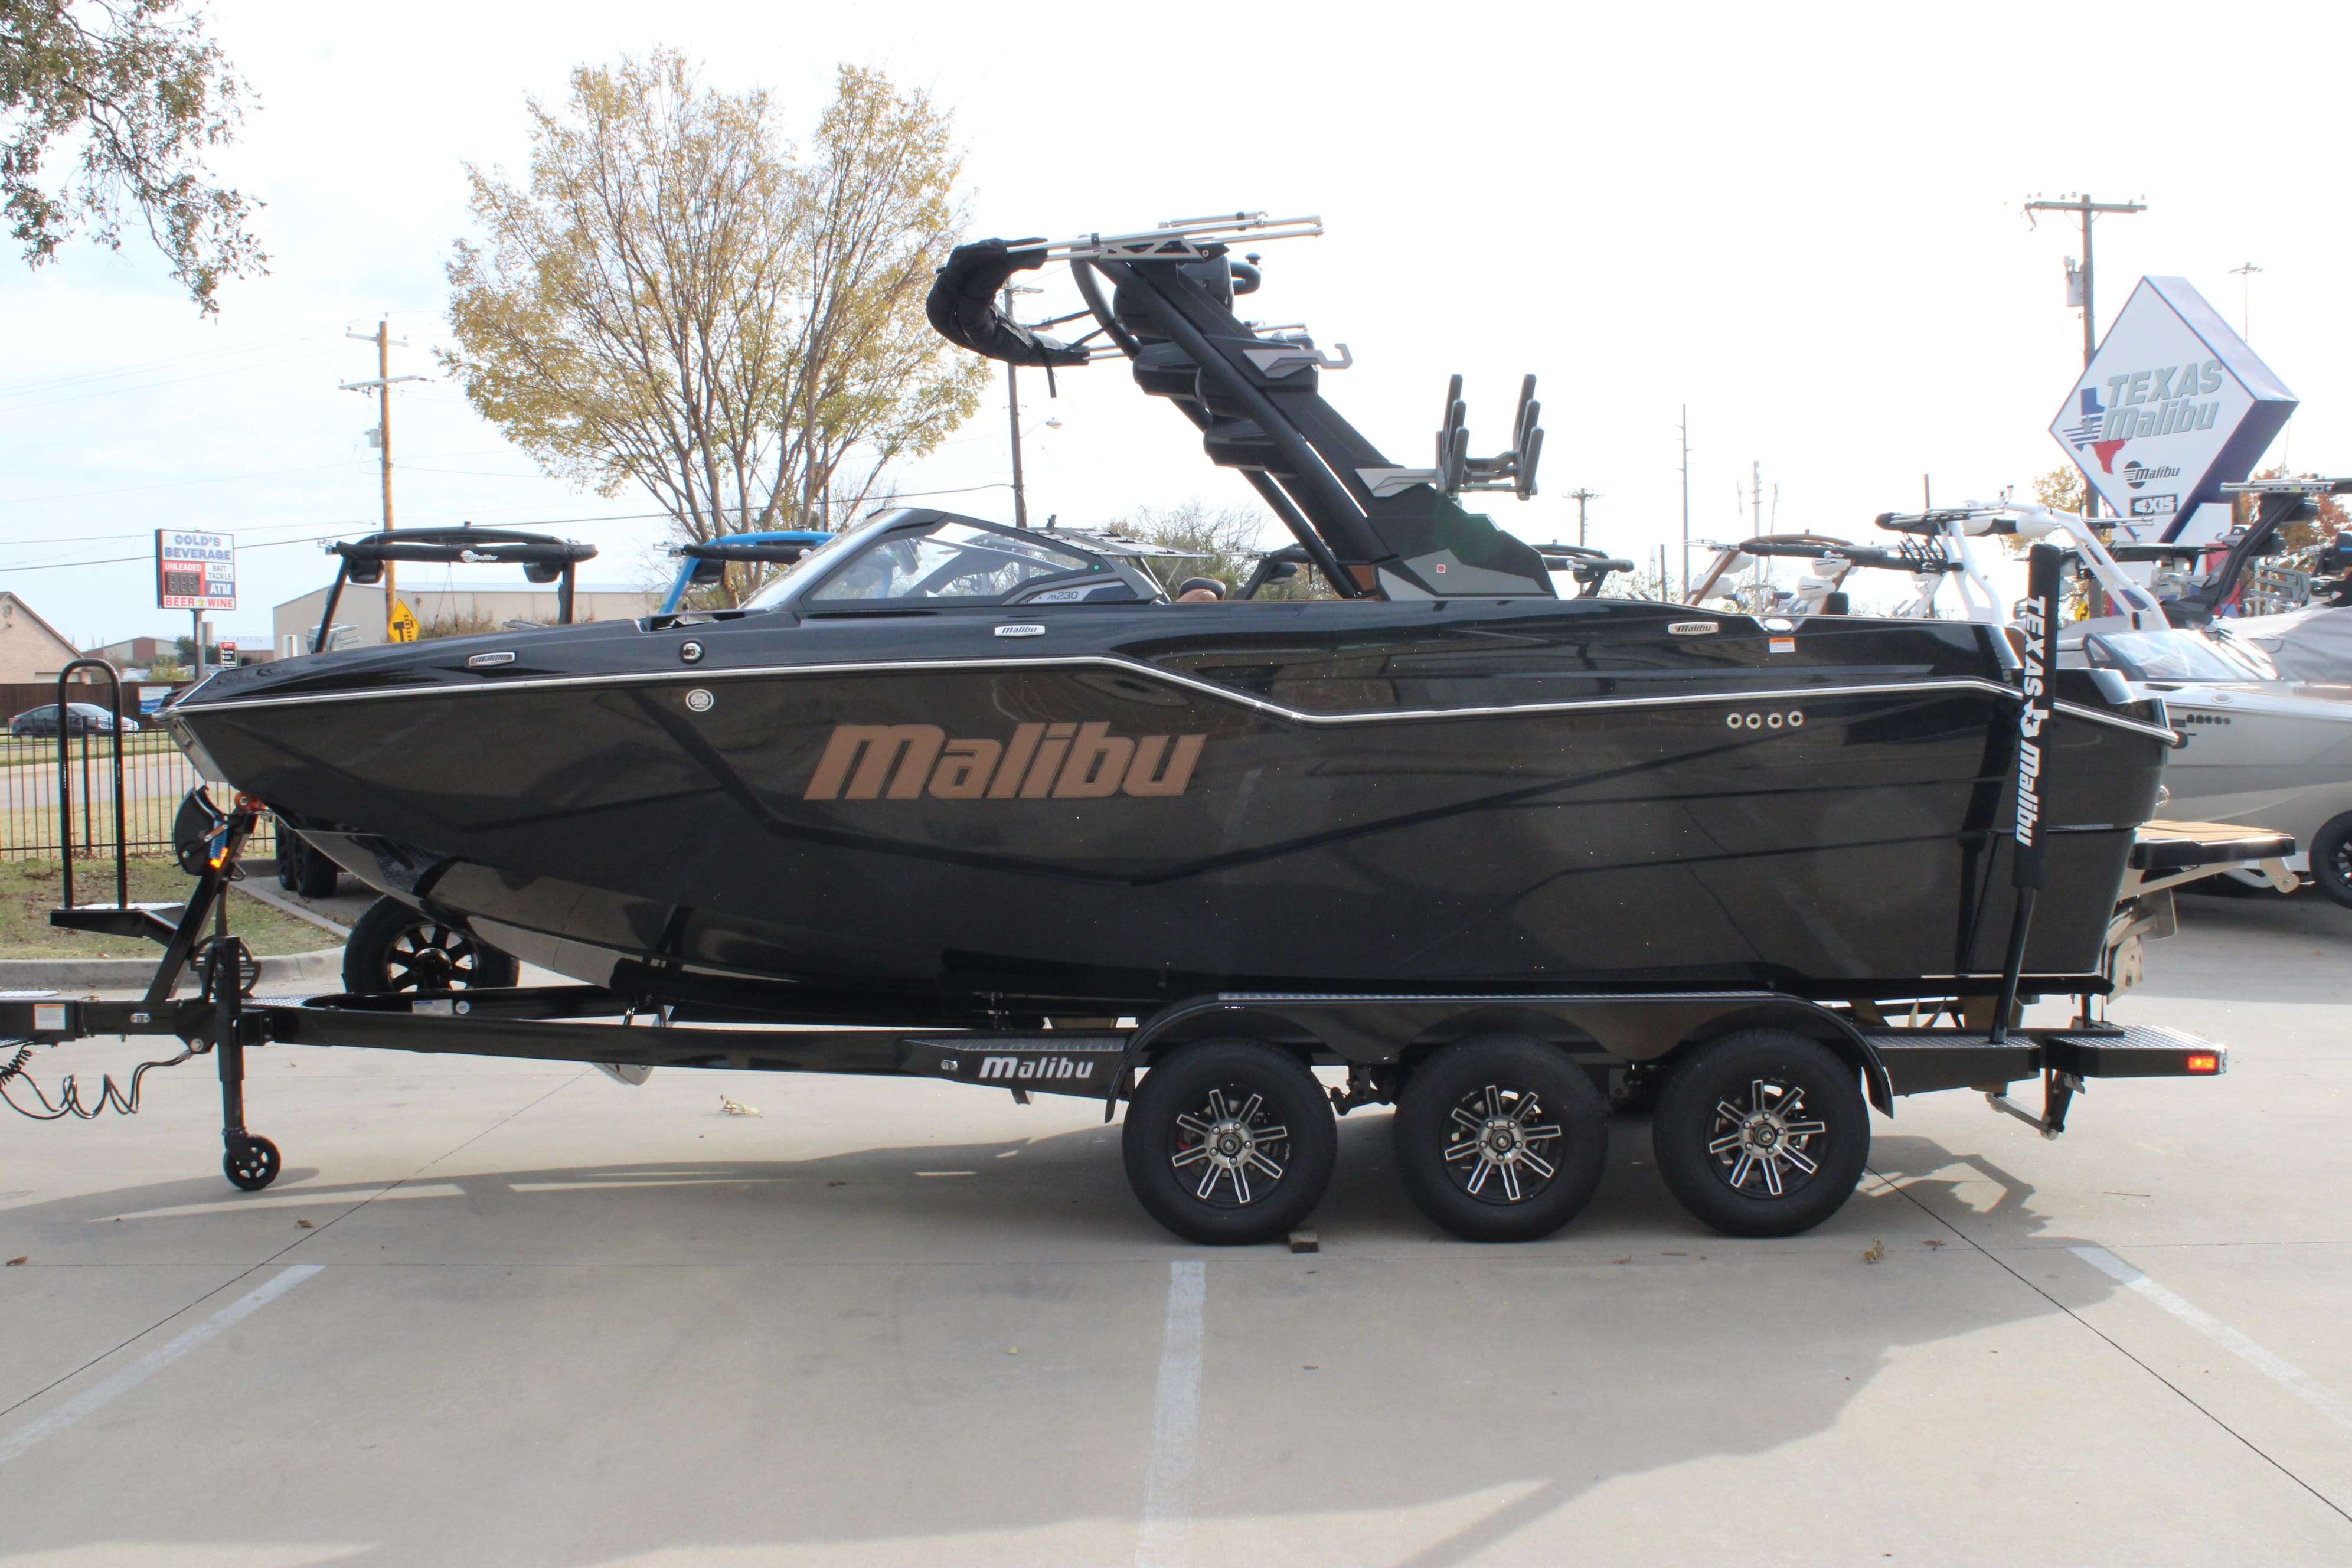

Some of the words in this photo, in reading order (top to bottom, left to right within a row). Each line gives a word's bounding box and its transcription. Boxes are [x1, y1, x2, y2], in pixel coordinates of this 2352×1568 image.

[2108, 359, 2222, 409] TEXAS
[2099, 398, 2220, 442] Malibu
[2134, 465, 2181, 481] Malibu
[175, 534, 221, 547] COLD'S
[164, 547, 231, 561] BEVERAGE
[165, 563, 202, 572] UNLEADED
[208, 571, 232, 580] TACKLE
[210, 583, 232, 596] ATM
[166, 596, 195, 606] BEER
[207, 597, 233, 608] WINE
[2023, 595, 2046, 697] TEXAS
[803, 721, 1208, 801] Malibu
[2015, 739, 2041, 847] Malibu
[979, 1057, 1094, 1079] Malibu
